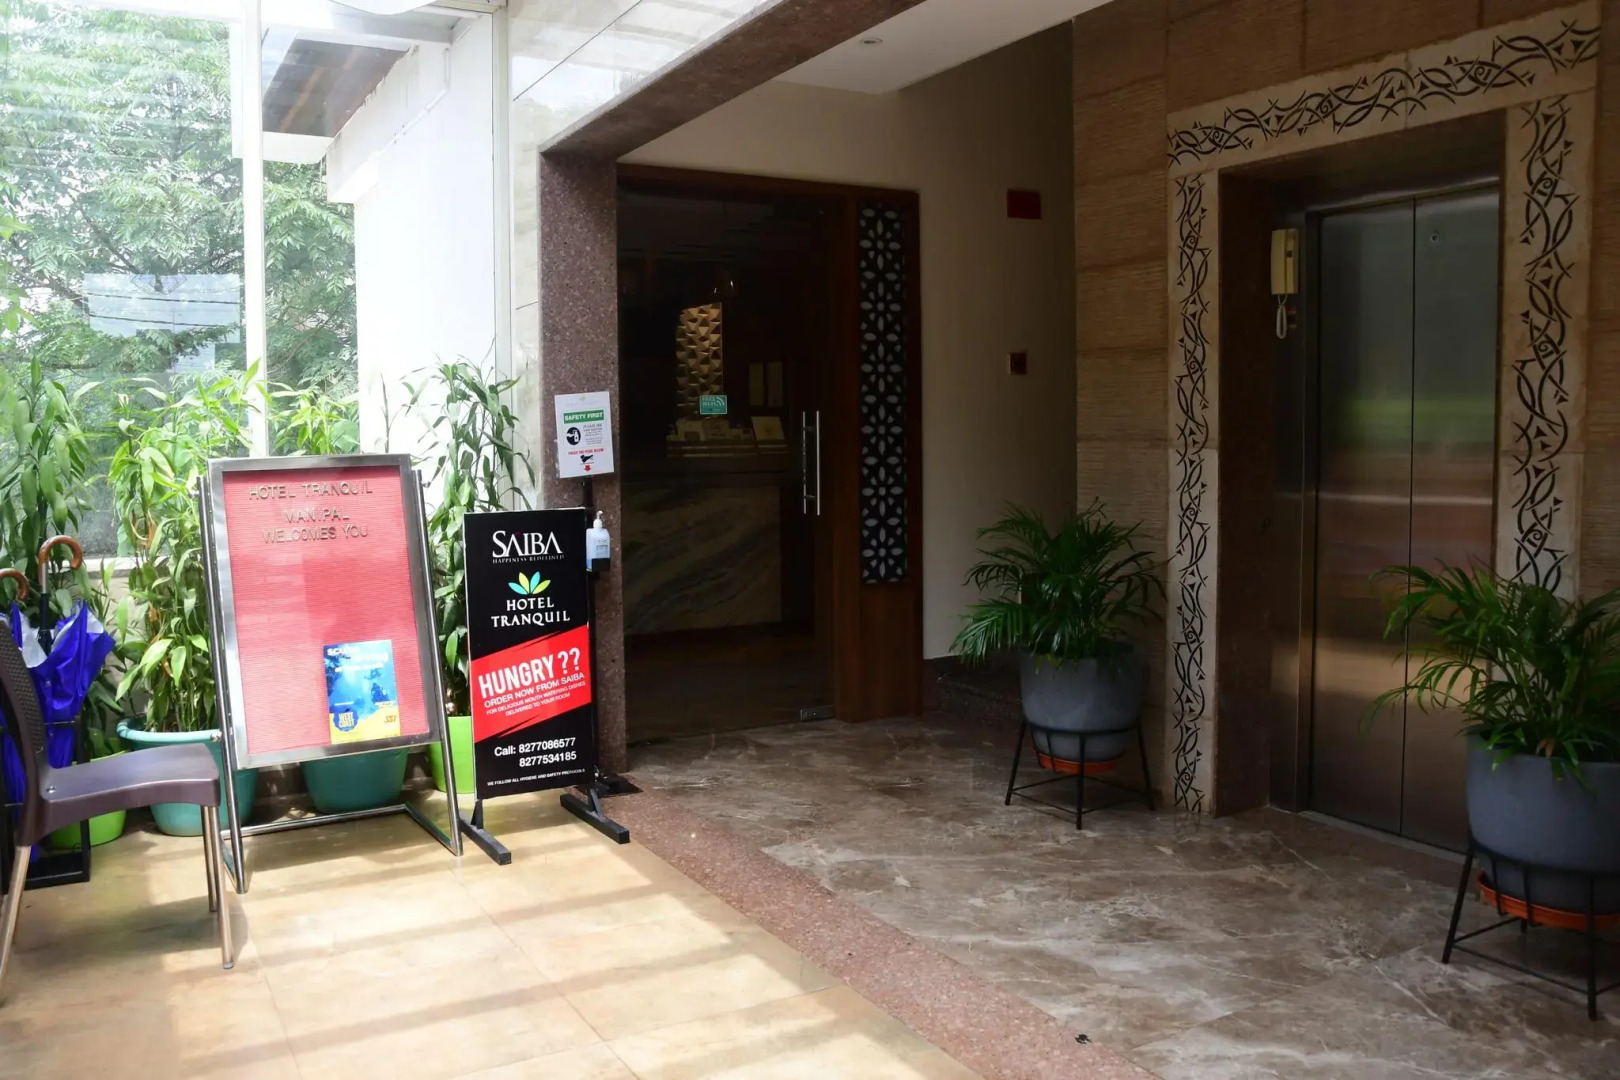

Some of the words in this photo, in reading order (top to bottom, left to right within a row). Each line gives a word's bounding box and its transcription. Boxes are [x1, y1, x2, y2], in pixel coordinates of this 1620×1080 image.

[564, 413, 586, 421] SAFETY
[249, 484, 296, 500] HOTEL
[302, 481, 373, 497] TRANQUIL
[283, 507, 350, 523] MANIPAL
[262, 526, 336, 543] WELCOMES
[341, 524, 369, 539] YOU
[492, 530, 563, 557] SAIBA
[506, 597, 554, 611] HOTEL
[491, 611, 570, 627] TRANQUIL
[478, 654, 554, 699] HUNGRY
[557, 647, 580, 675] ??
[484, 693, 513, 708] ORDER
[515, 687, 534, 699] NOW
[536, 680, 559, 692] FROM
[561, 672, 585, 684] SAIBA
[498, 700, 524, 712] DELICIOUS
[525, 694, 542, 704] MOUTH
[506, 704, 532, 716] DELIVERED
[541, 697, 554, 705] YOUR
[554, 692, 570, 701] ROOM
[494, 745, 516, 756] Call:
[518, 737, 576, 753] 8277086577
[519, 751, 577, 767] 8277534185
